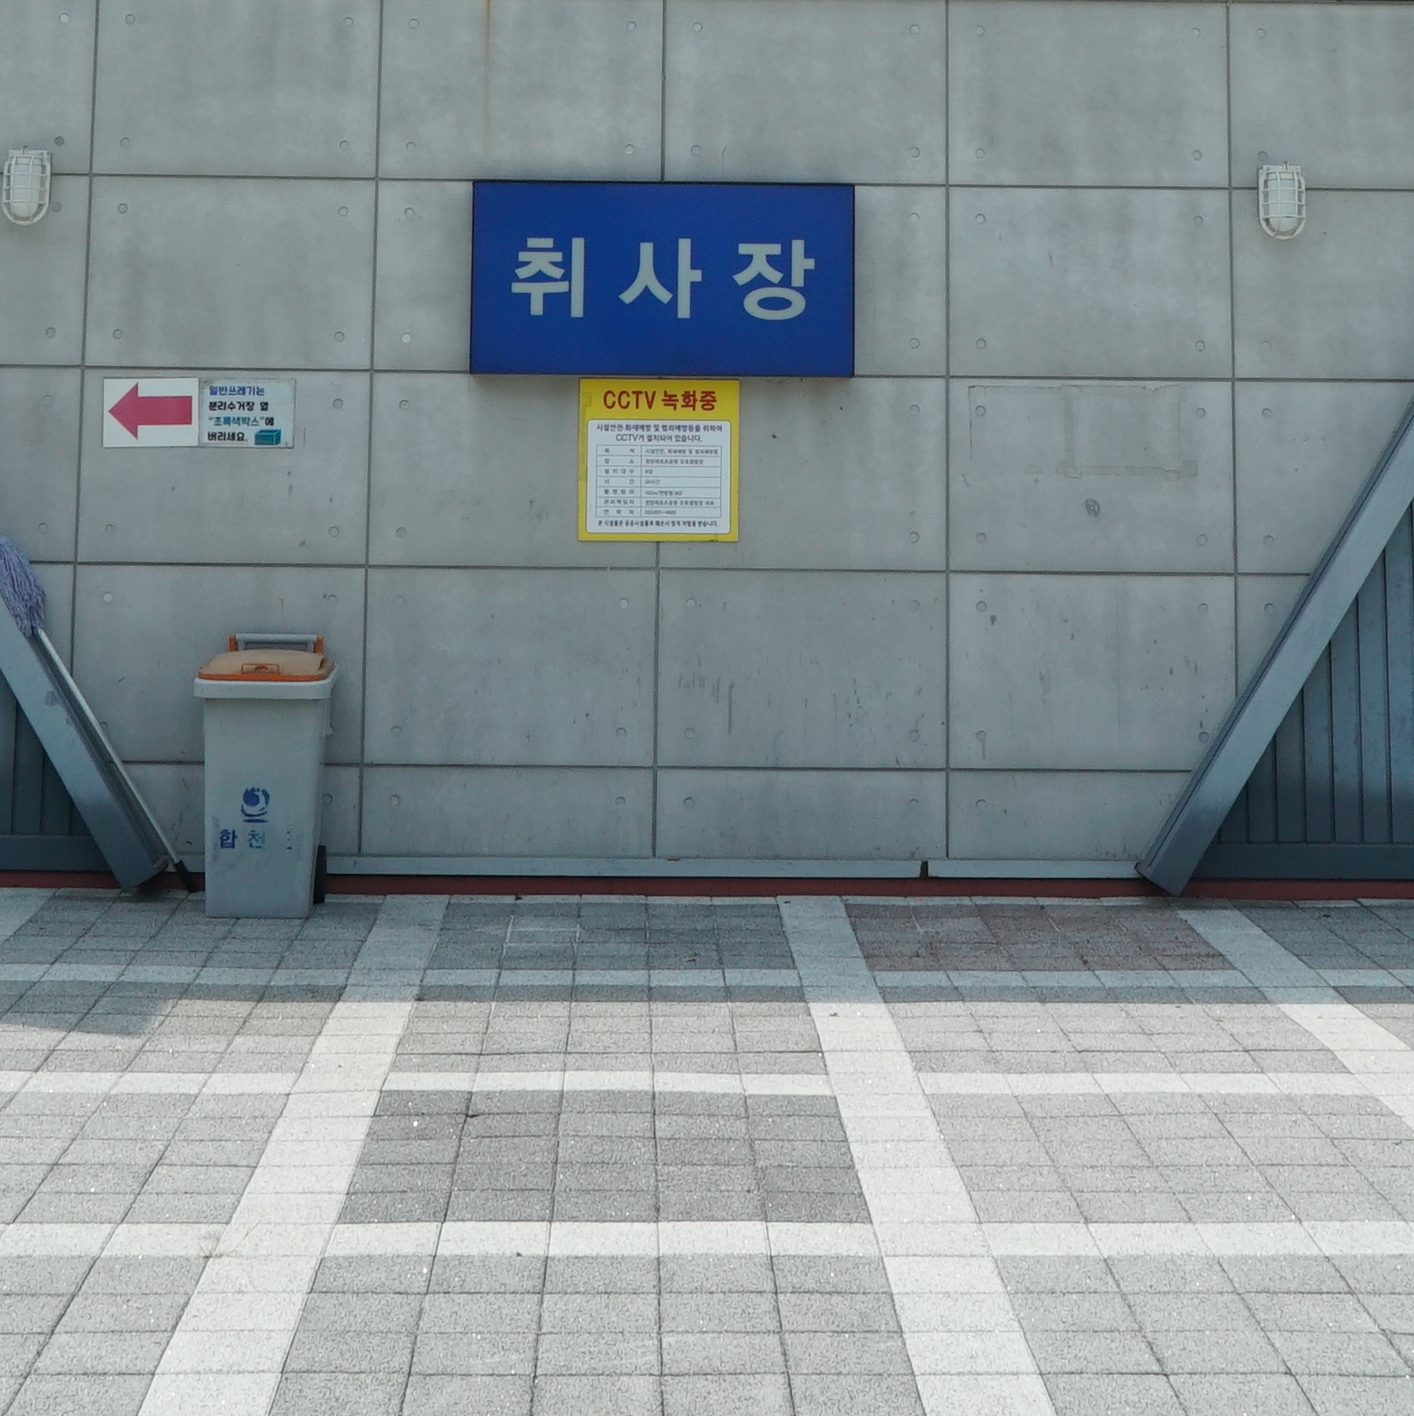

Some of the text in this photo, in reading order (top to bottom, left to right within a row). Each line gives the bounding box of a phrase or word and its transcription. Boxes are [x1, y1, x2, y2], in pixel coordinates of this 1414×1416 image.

[511, 237, 815, 320] 취사장
[208, 385, 265, 396] 일반쓰레기는
[603, 390, 717, 411] CCTV 녹화중
[208, 401, 255, 412] 분리수거장
[207, 431, 248, 442] 버리세요.
